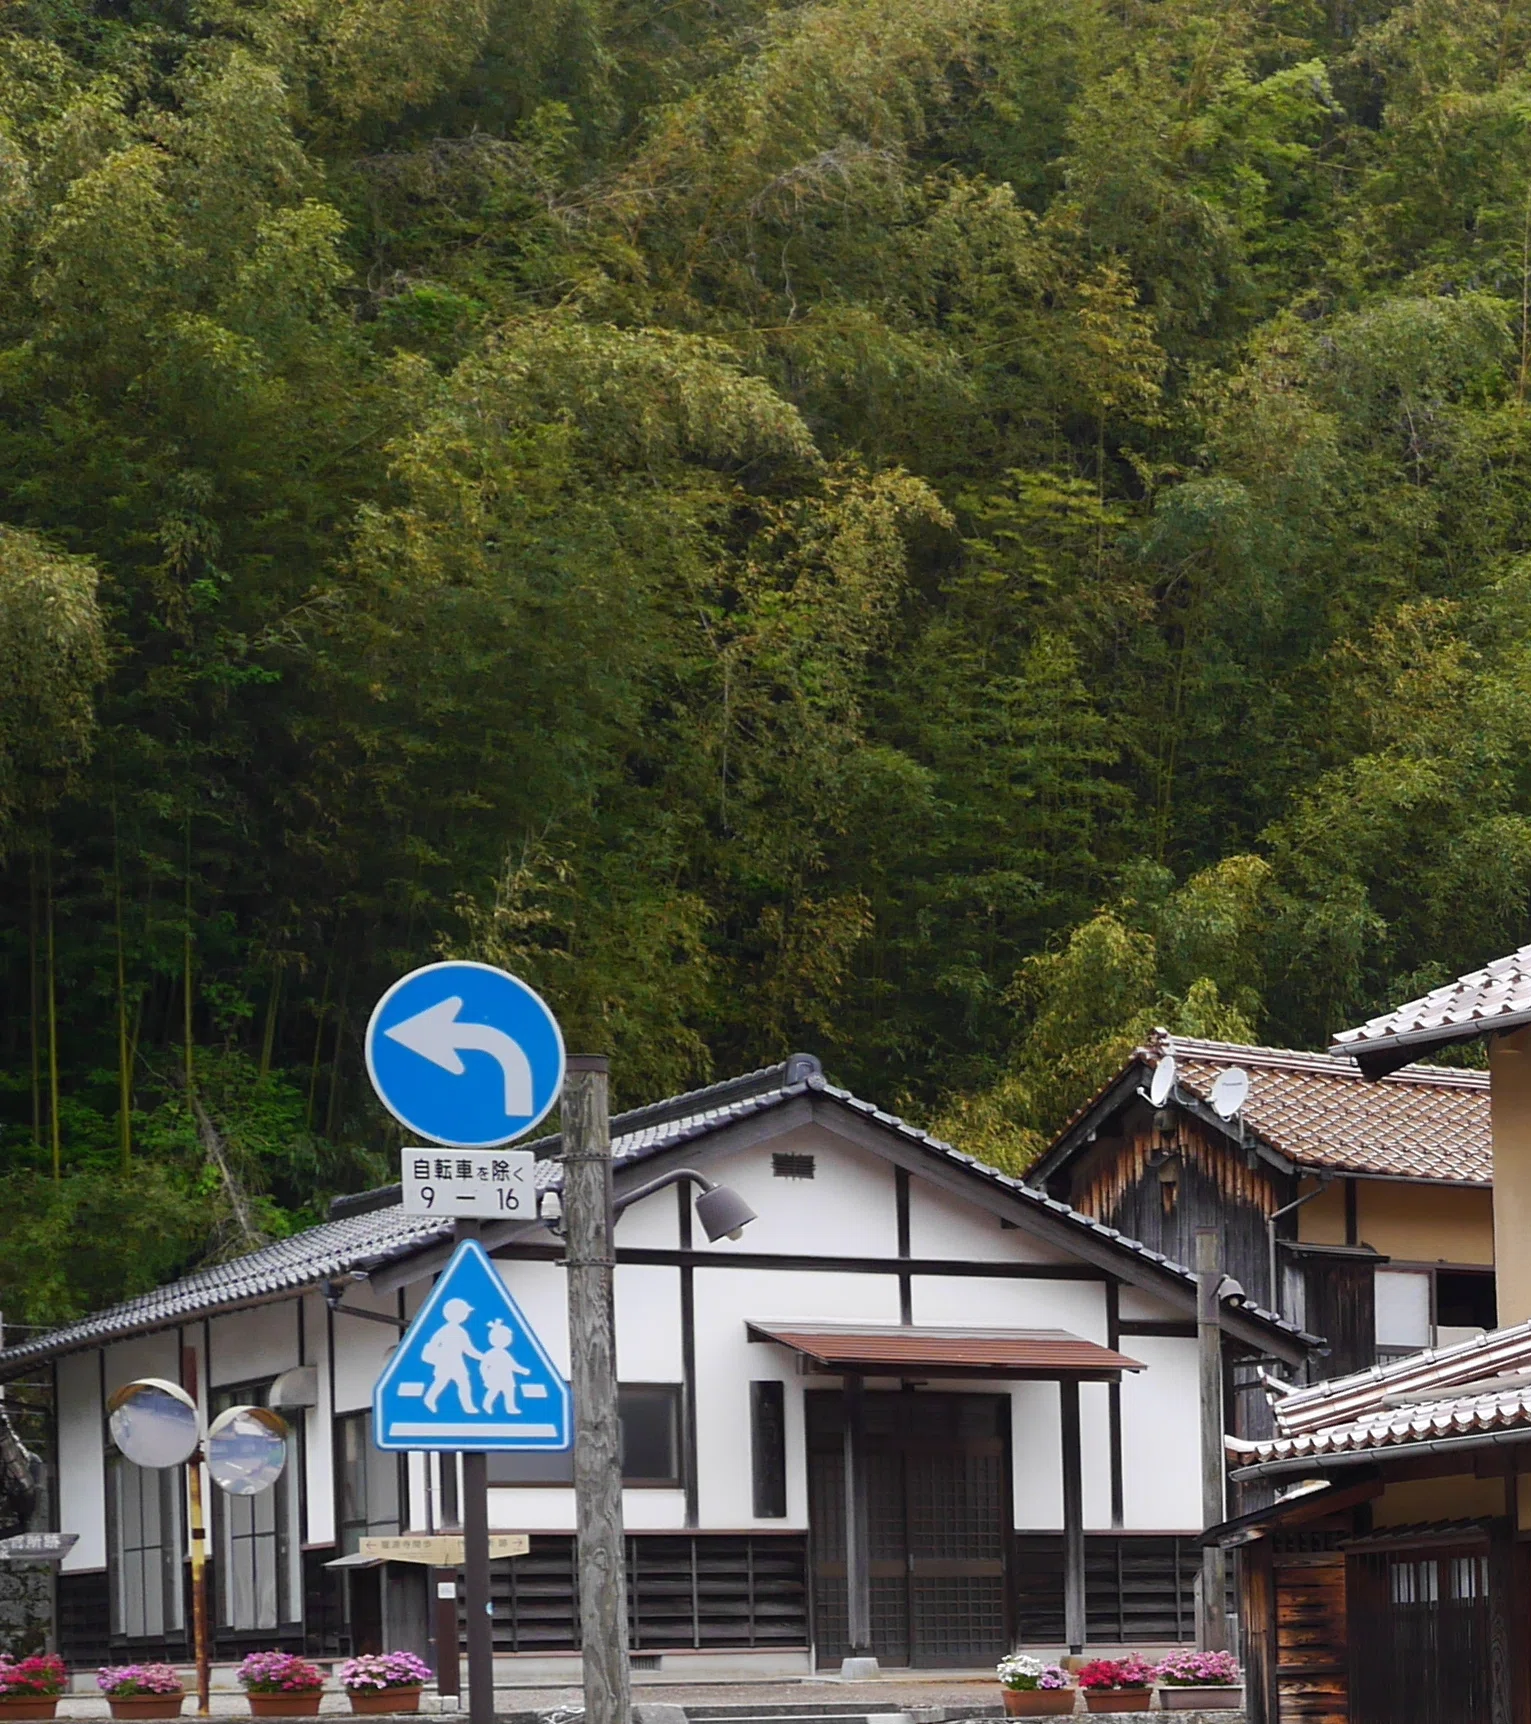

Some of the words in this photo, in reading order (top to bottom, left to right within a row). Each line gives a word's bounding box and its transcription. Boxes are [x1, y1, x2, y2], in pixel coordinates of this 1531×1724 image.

[414, 1158, 524, 1181] 自転車を除く
